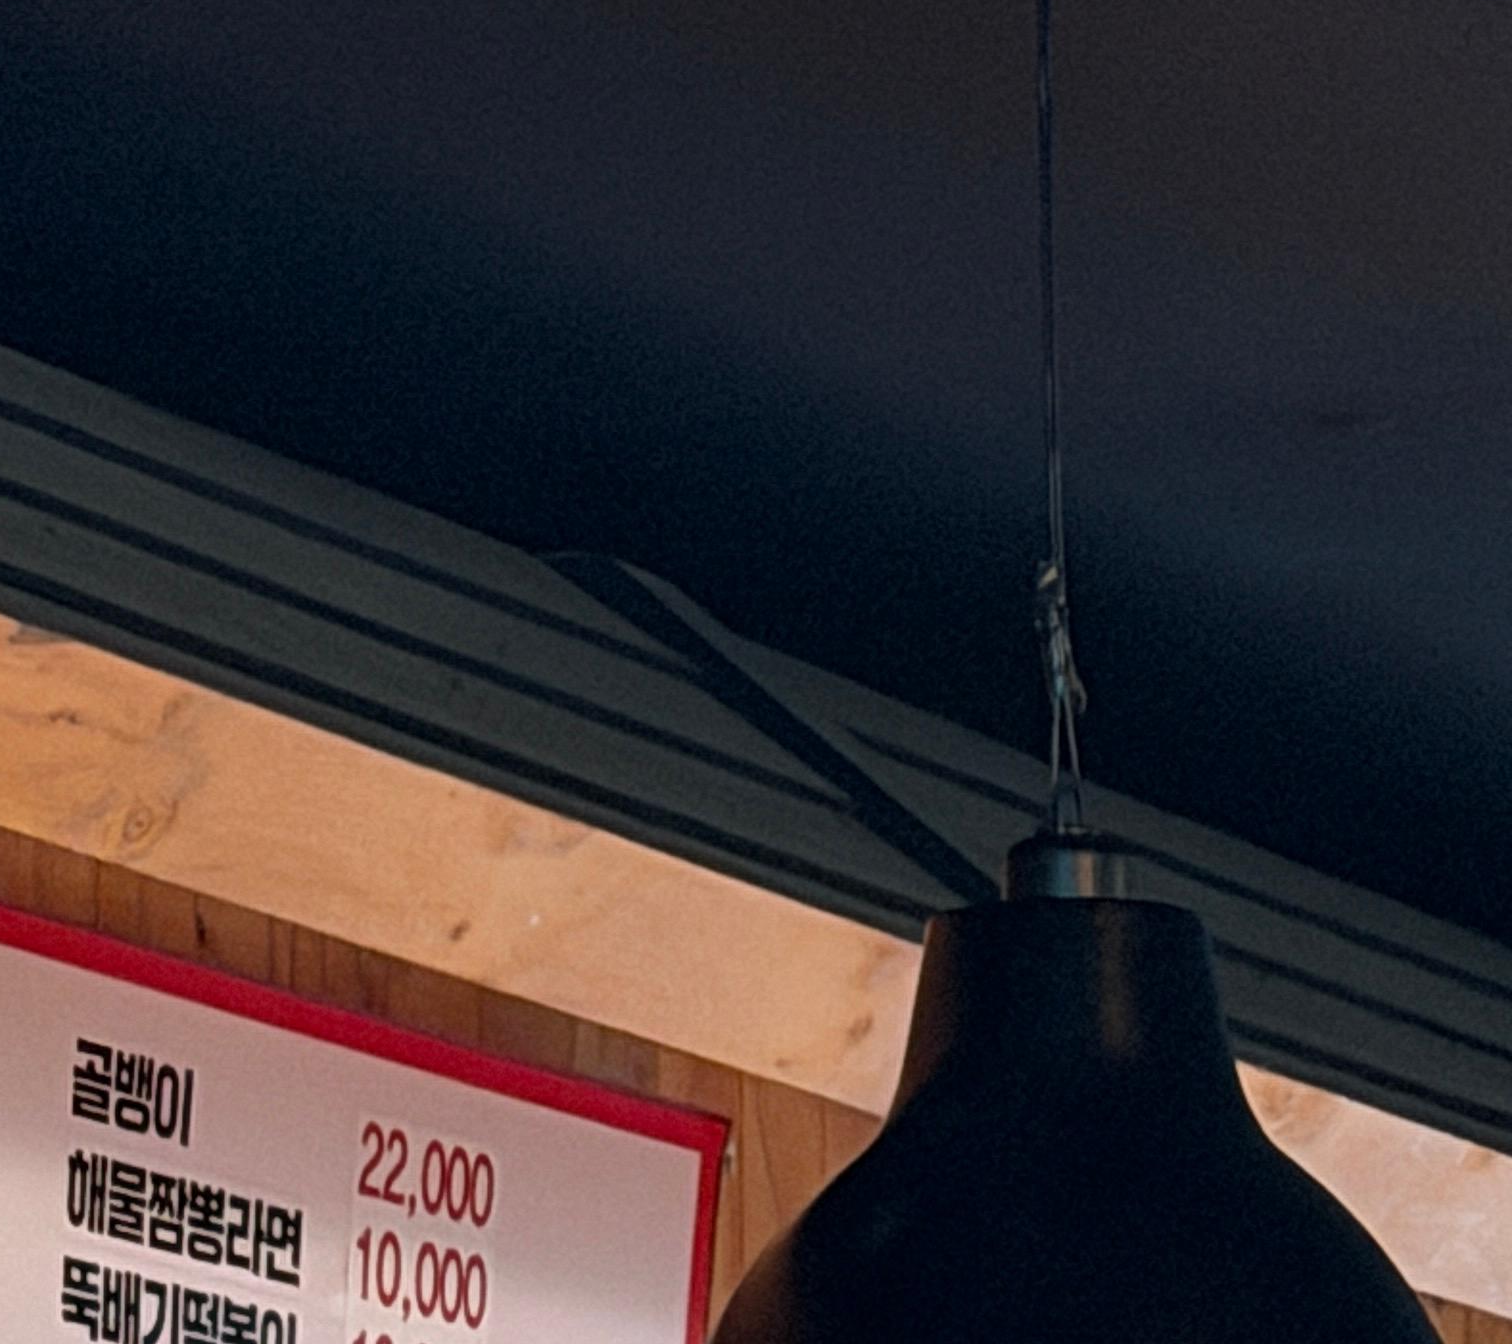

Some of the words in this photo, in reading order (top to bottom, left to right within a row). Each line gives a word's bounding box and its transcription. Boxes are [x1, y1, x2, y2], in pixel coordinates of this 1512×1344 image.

[72, 1038, 194, 1147] 골뱅이
[67, 1149, 303, 1287] 해물짬뽕라면
[358, 1121, 494, 1227] 22,000
[356, 1227, 487, 1329] 10,000
